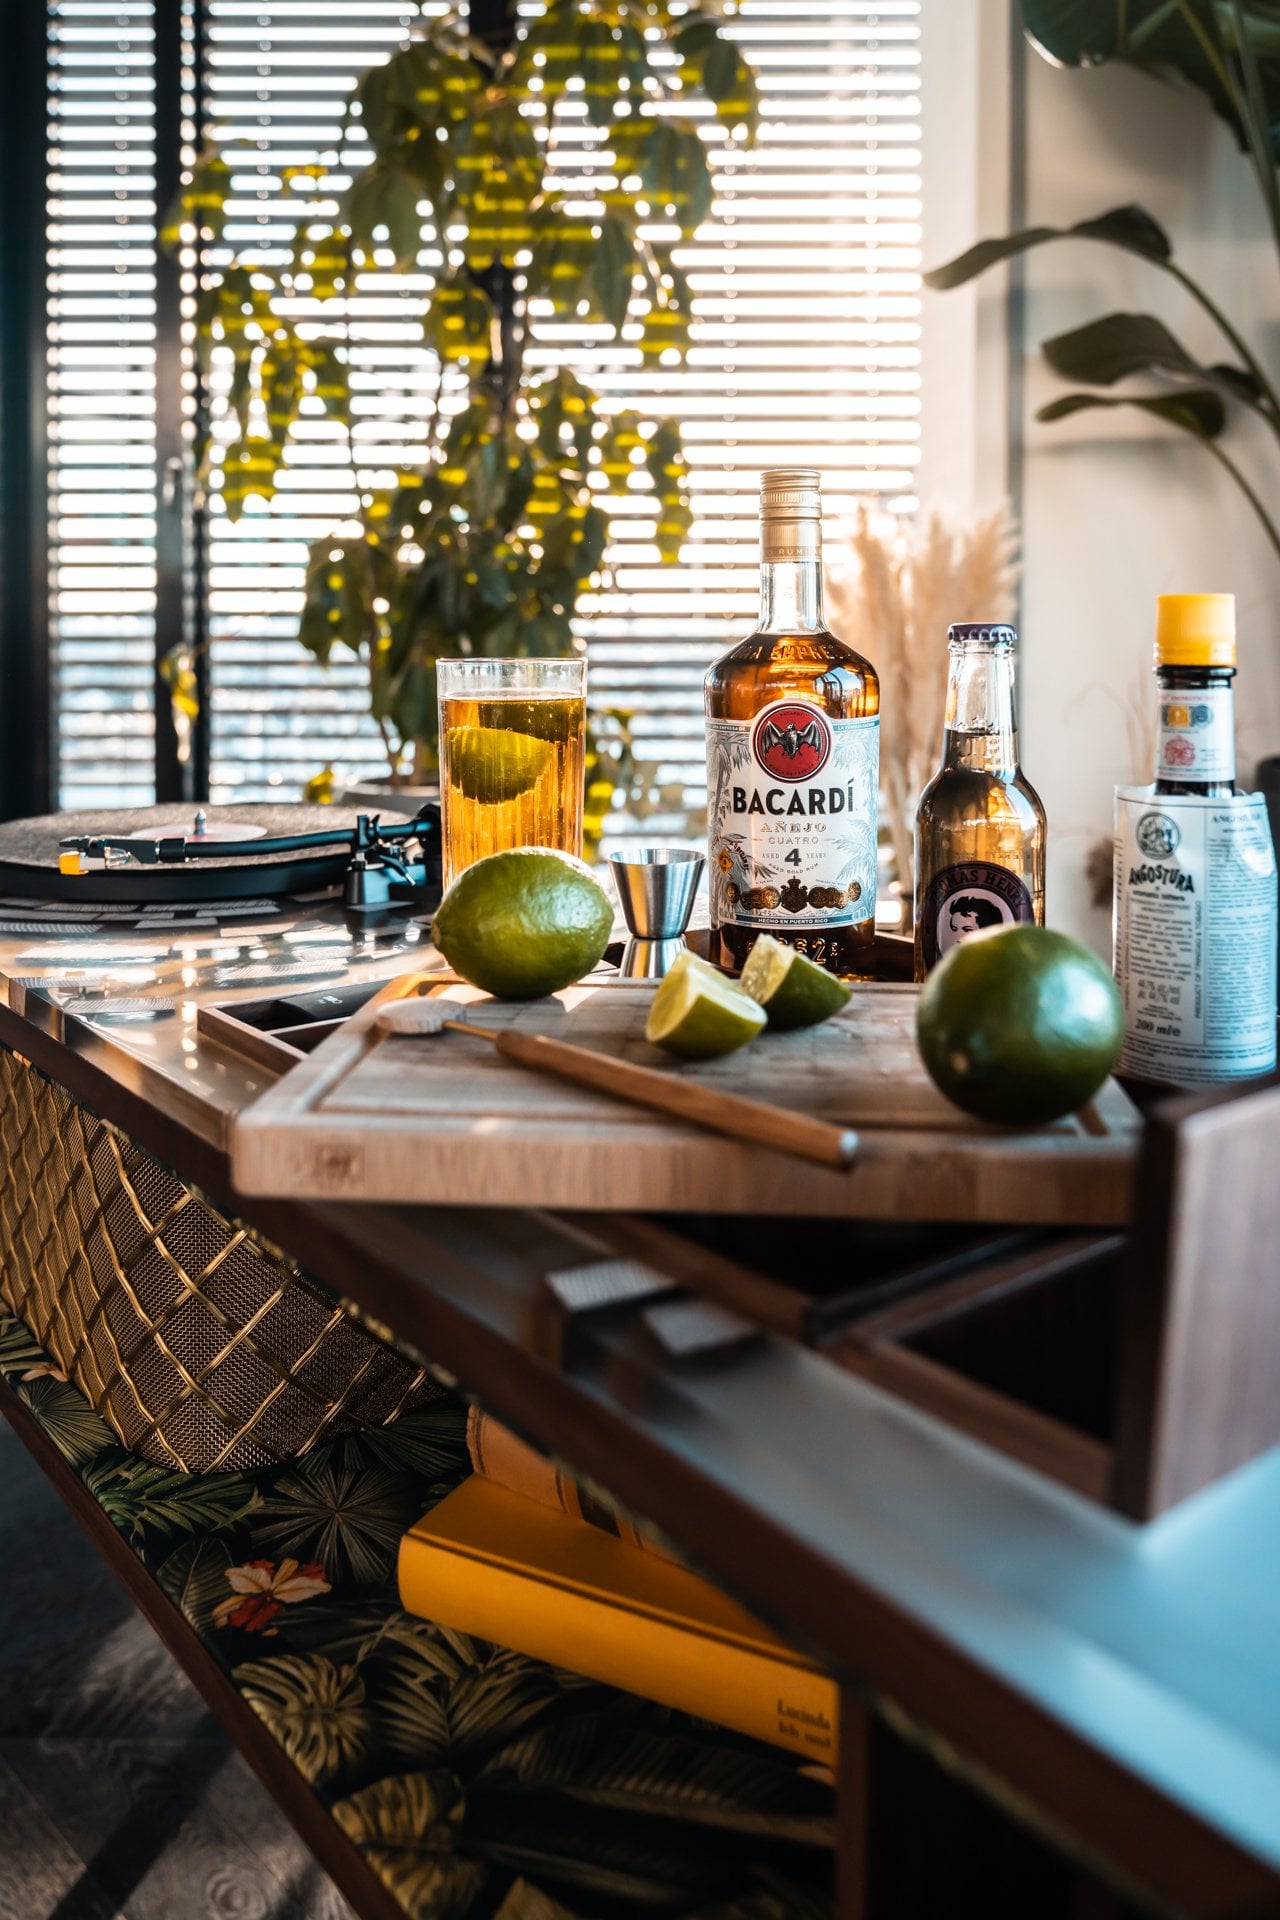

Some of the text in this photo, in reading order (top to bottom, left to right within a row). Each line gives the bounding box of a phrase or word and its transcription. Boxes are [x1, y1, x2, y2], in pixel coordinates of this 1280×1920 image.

[778, 548, 803, 556] RUM
[733, 777, 854, 816] BACARDÍ
[760, 821, 827, 834] AÑEJO
[768, 836, 820, 845] CUATRO
[762, 848, 827, 867] AGED 4 YEARS
[805, 861, 819, 872] RUM
[1128, 864, 1195, 894] ANGOSTURA
[983, 871, 1028, 908] HENRY
[780, 917, 789, 925] EN
[789, 917, 814, 925] PUERTO
[1135, 1018, 1155, 1033] 200
[777, 1697, 831, 1730] Lucinda
